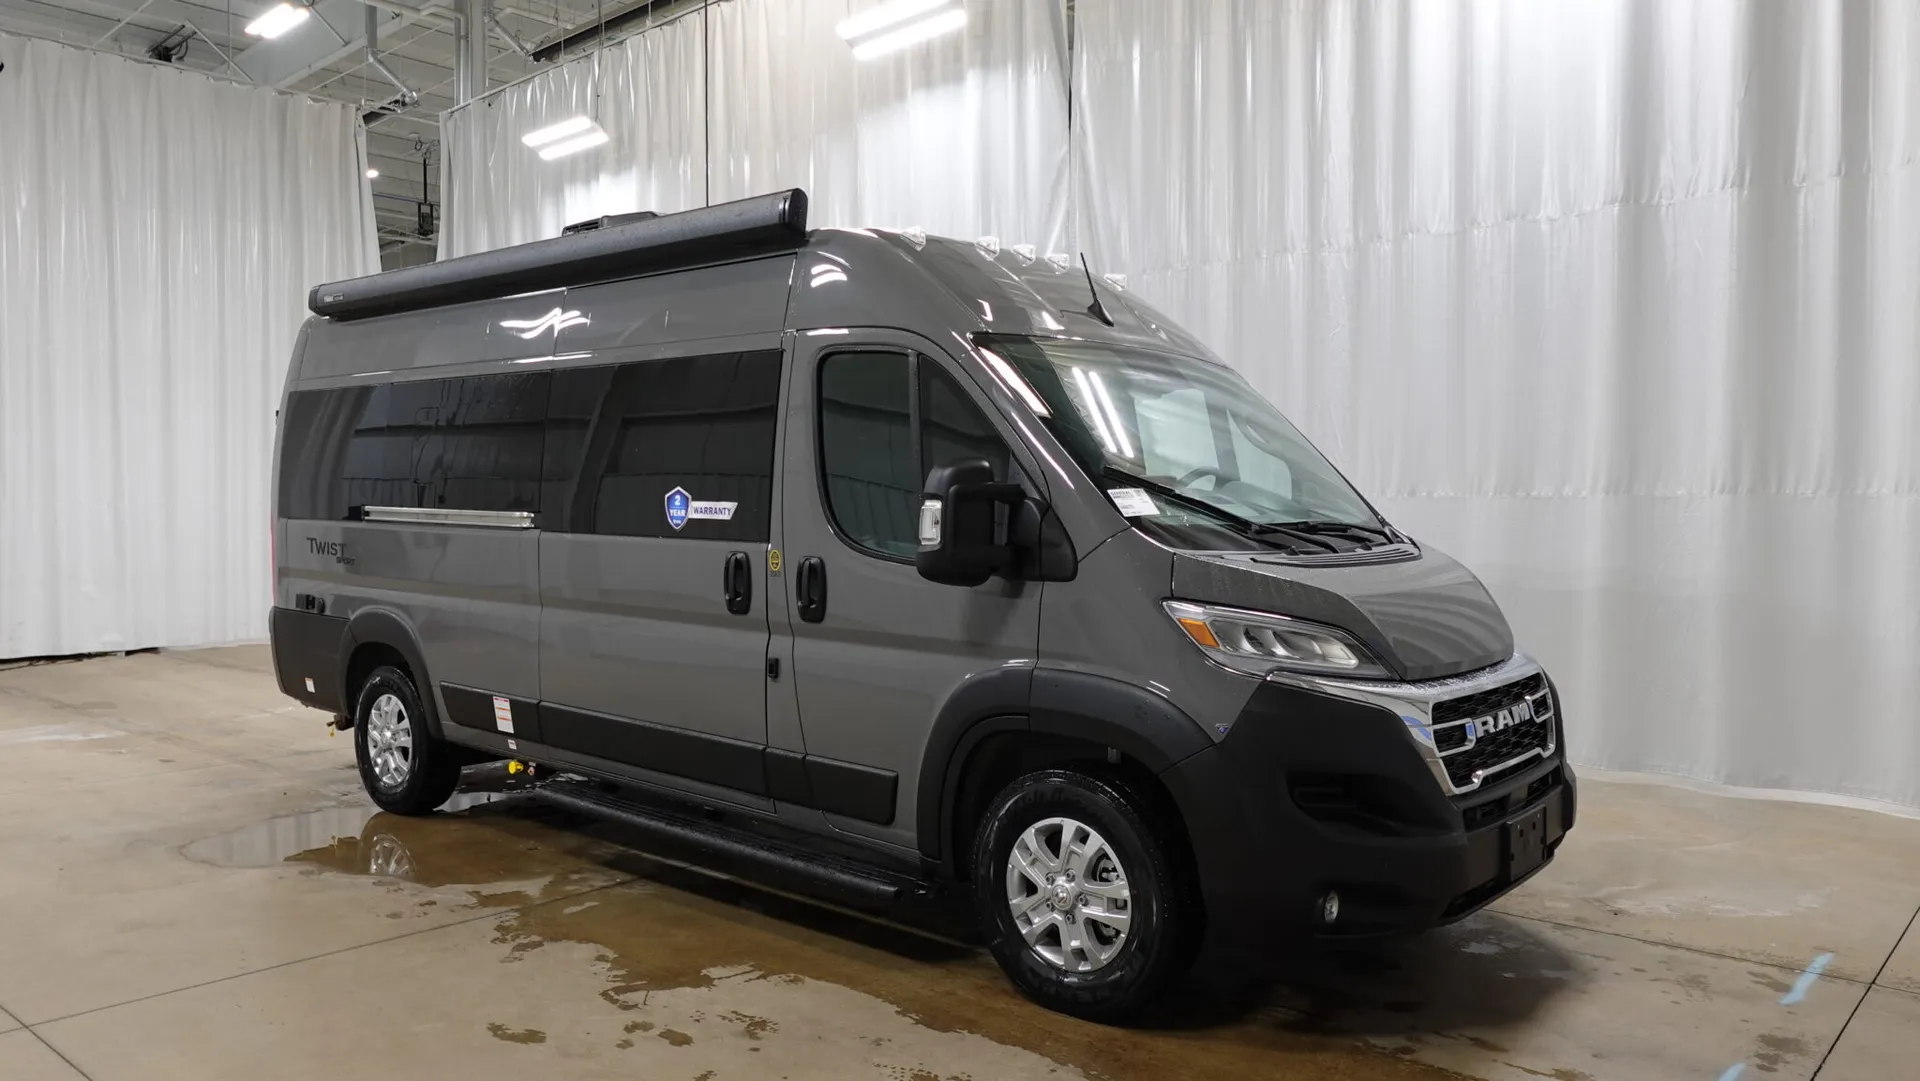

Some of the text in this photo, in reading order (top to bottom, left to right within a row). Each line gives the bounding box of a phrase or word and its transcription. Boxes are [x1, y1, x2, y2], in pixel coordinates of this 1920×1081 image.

[674, 494, 681, 506] 2
[669, 509, 686, 517] YEAR
[693, 506, 732, 516] WARRANTY
[1473, 702, 1531, 738] RAM
